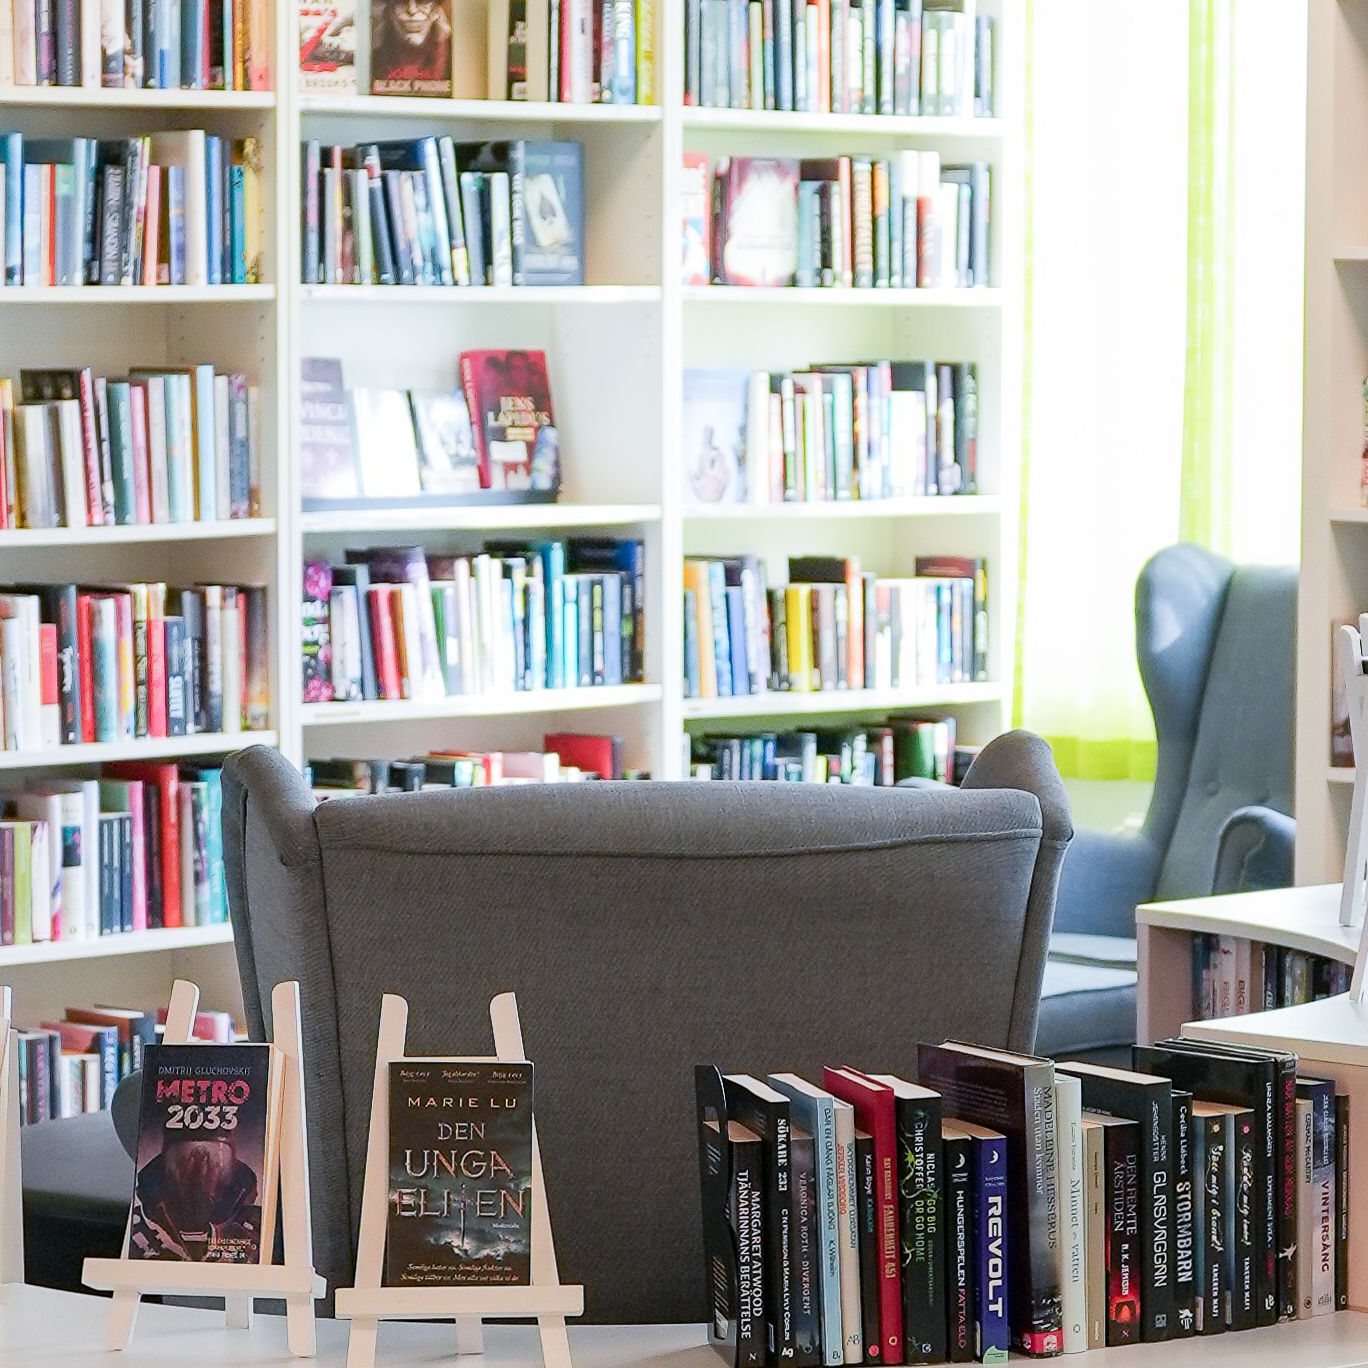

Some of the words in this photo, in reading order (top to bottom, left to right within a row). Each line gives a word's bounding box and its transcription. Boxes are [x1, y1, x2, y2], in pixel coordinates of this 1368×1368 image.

[156, 1080, 250, 1104] METRO
[408, 1097, 479, 1108] MARIE
[491, 1098, 516, 1108] LU
[166, 1105, 238, 1130] 2033
[438, 1122, 485, 1140] DEN
[405, 1149, 515, 1179] UNGA
[776, 1119, 789, 1166] SÖKARE
[778, 1172, 787, 1191] 233
[1126, 1154, 1136, 1185] DEN
[737, 1170, 751, 1263] TJÄNARINNANS
[1070, 1179, 1080, 1228] Minnet
[1113, 1160, 1125, 1232] ÅRSTIDEN
[1126, 1187, 1137, 1236] FEMTE
[750, 1191, 761, 1258] MARGARET
[988, 1196, 1003, 1318] REVOLT
[1072, 1243, 1081, 1283] vatten
[739, 1265, 753, 1338] BERÄTTELSE
[752, 1260, 763, 1316] ATWOOD
